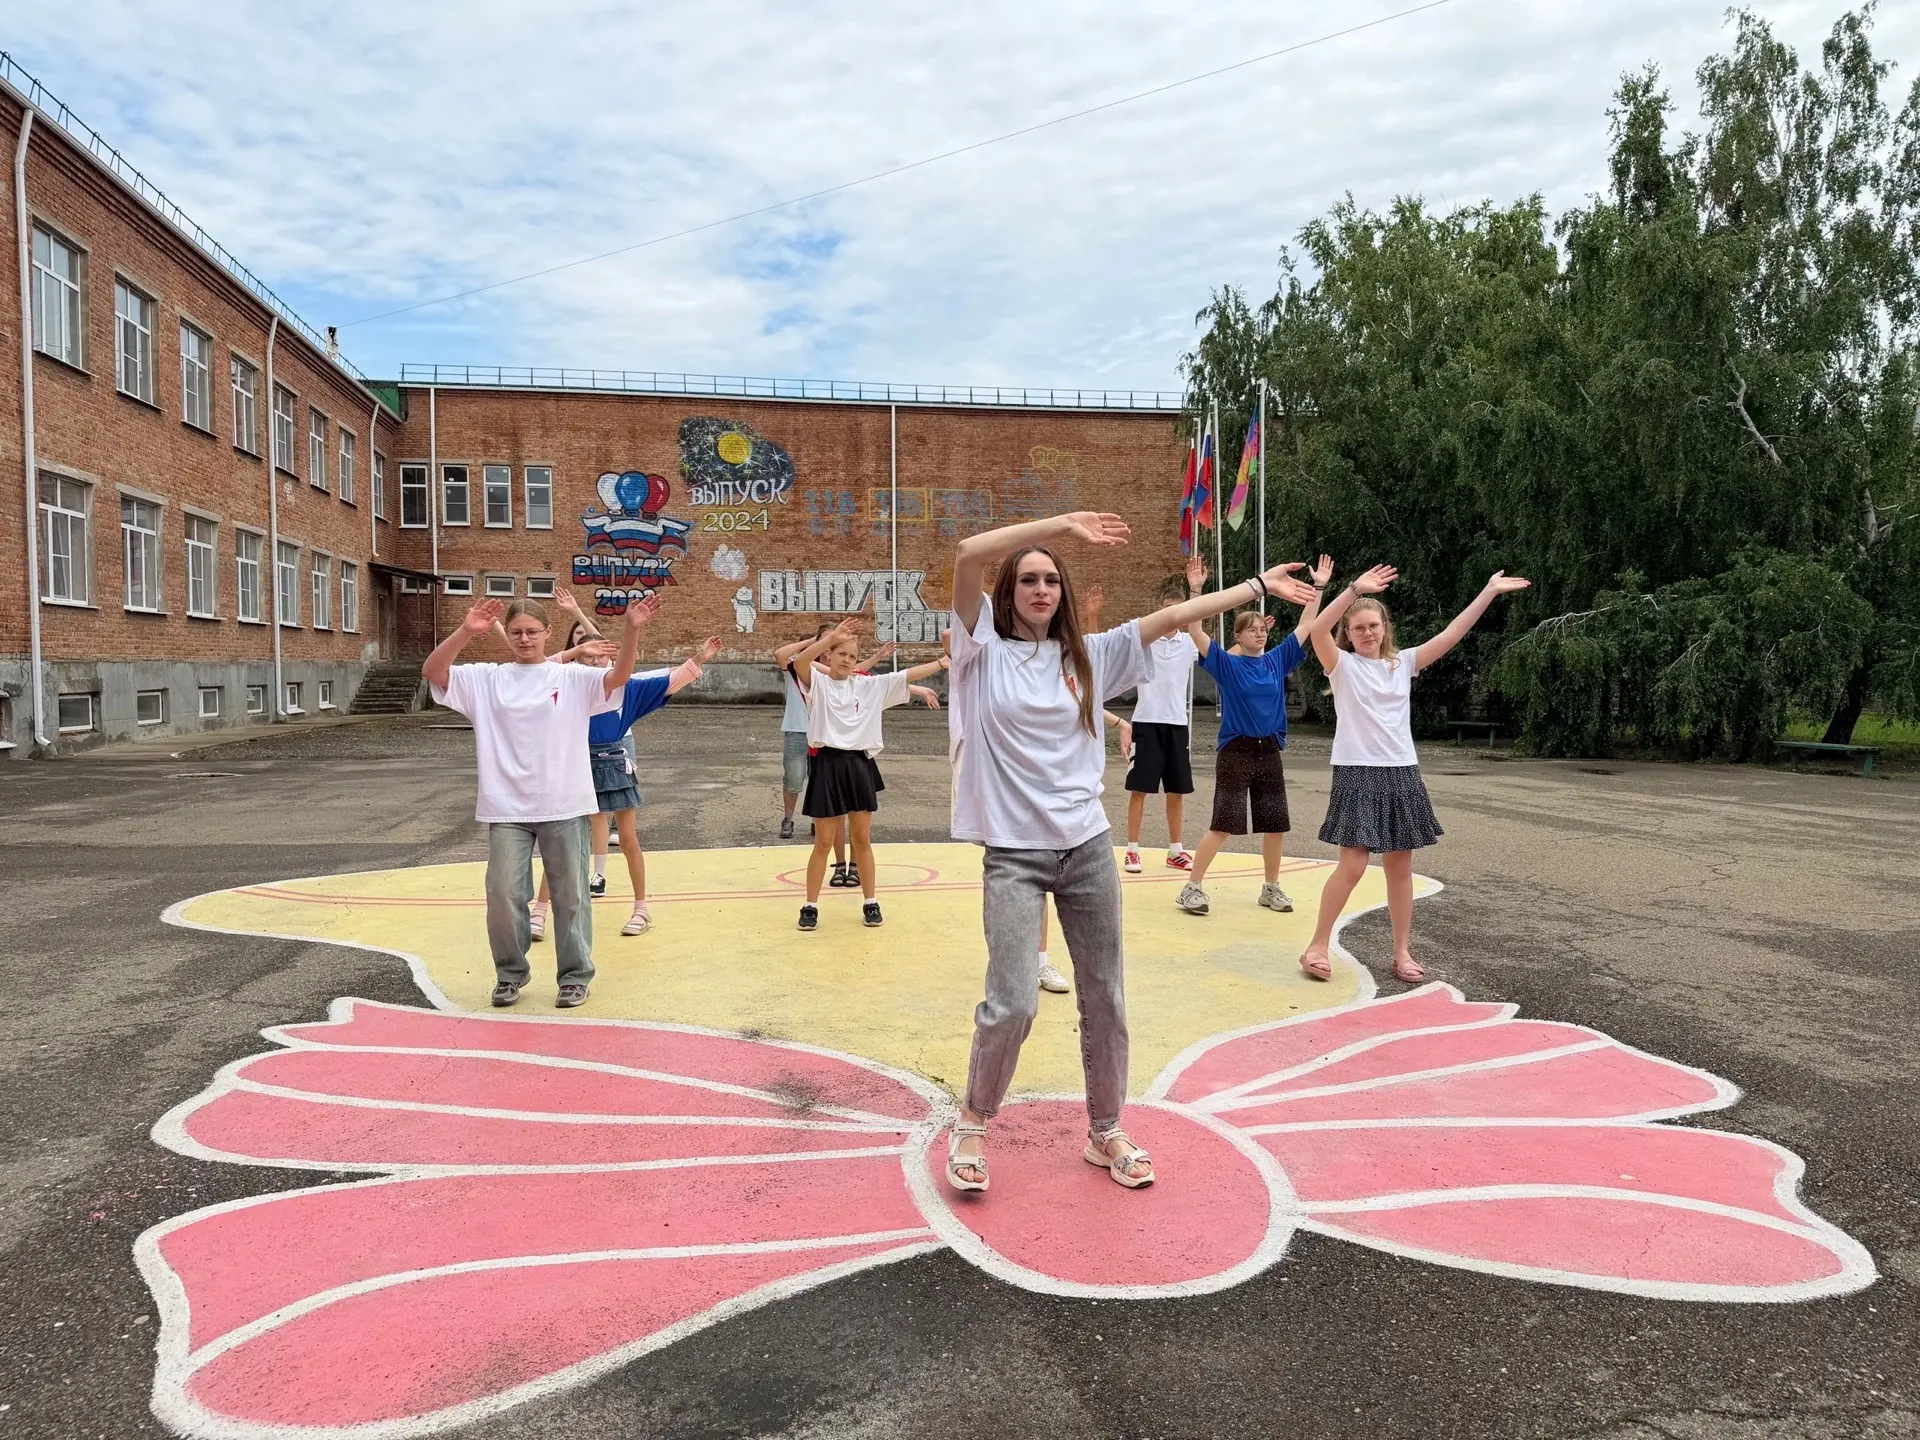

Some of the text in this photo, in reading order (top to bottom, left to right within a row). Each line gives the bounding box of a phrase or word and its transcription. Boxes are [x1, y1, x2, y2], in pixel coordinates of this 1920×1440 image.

[685, 478, 789, 506] ВЫПУСК
[703, 508, 770, 532] 2024
[573, 553, 678, 588] ВЫПУСК
[759, 569, 930, 612] ВЫПУСК
